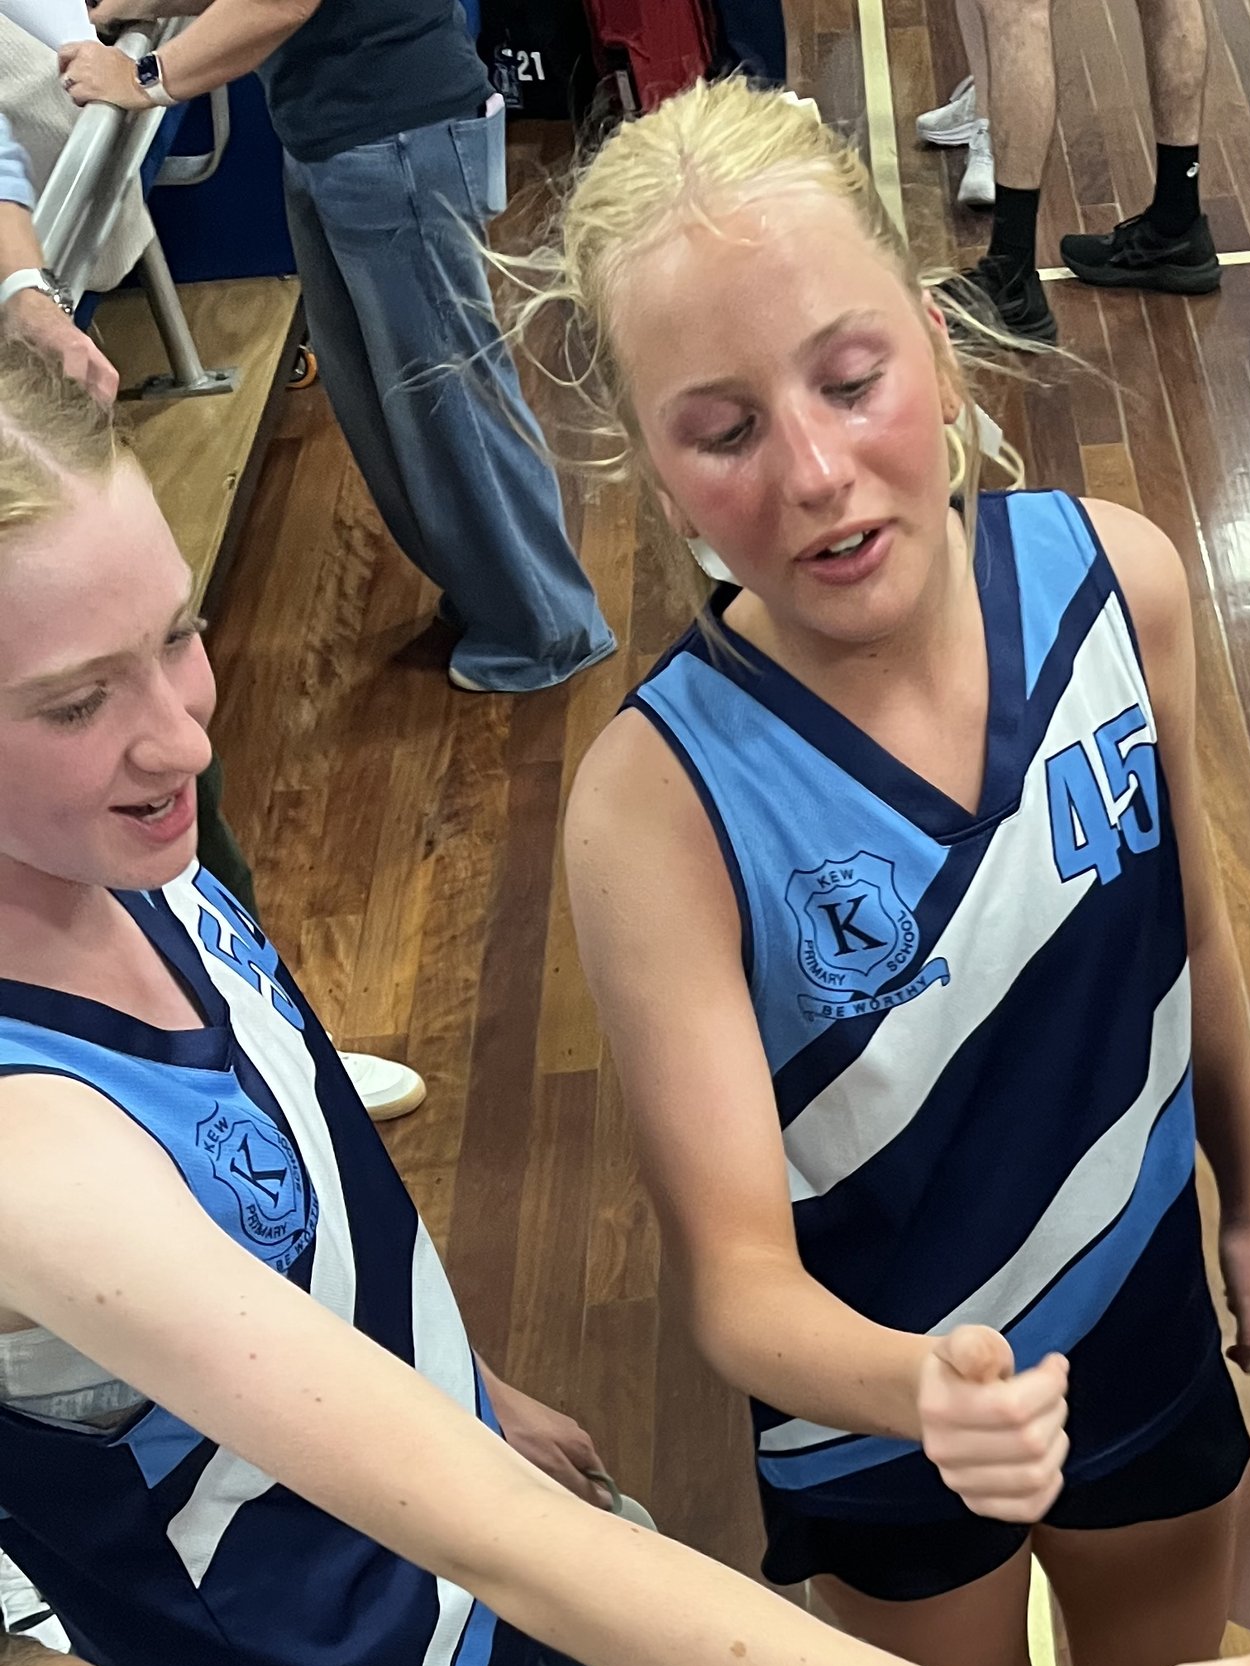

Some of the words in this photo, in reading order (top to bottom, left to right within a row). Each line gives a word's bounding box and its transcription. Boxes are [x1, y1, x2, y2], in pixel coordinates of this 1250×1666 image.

[1045, 702, 1161, 886] 45
[817, 868, 854, 889] KEW
[817, 893, 889, 957] K
[803, 939, 847, 987] PRIMARY
[887, 910, 916, 973] SCHOOL
[821, 1005, 845, 1018] BE
[854, 975, 928, 1015] WORTHY
[204, 1116, 230, 1154] KEW
[230, 1132, 288, 1209] K
[246, 1205, 288, 1240] PRIMARY
[275, 1246, 293, 1272] BE
